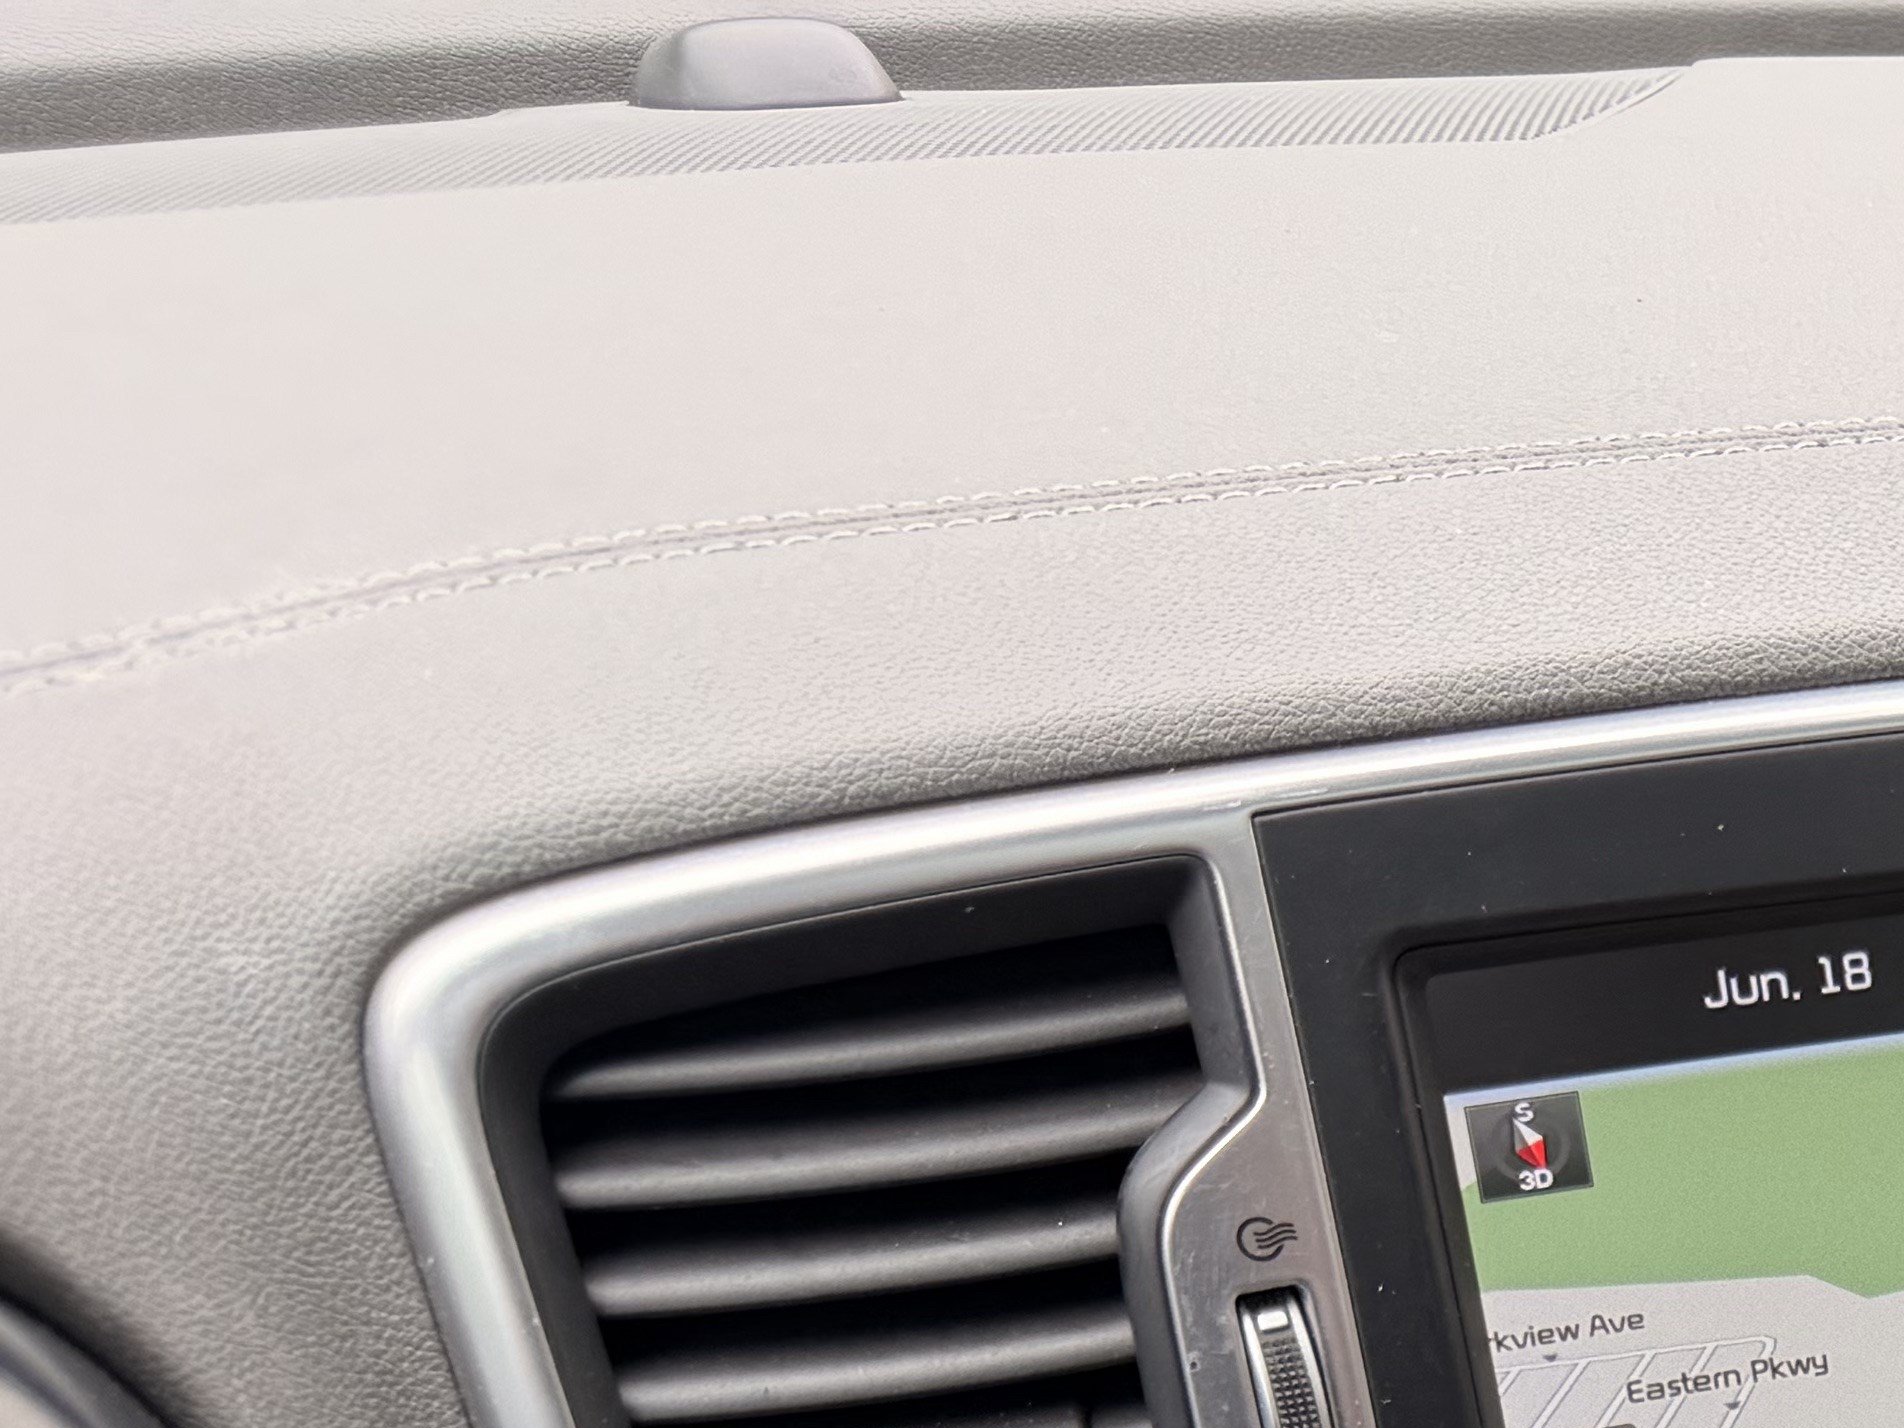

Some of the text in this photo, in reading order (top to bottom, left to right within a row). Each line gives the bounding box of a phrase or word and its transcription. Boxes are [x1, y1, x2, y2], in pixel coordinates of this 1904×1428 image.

[1703, 950, 1873, 1009] Jun. 18
[1514, 1102, 1534, 1122] S
[1519, 1168, 1553, 1190] 3D
[1589, 1312, 1646, 1337] Ave
[1626, 1353, 1830, 1404] Eastern Pkwy
